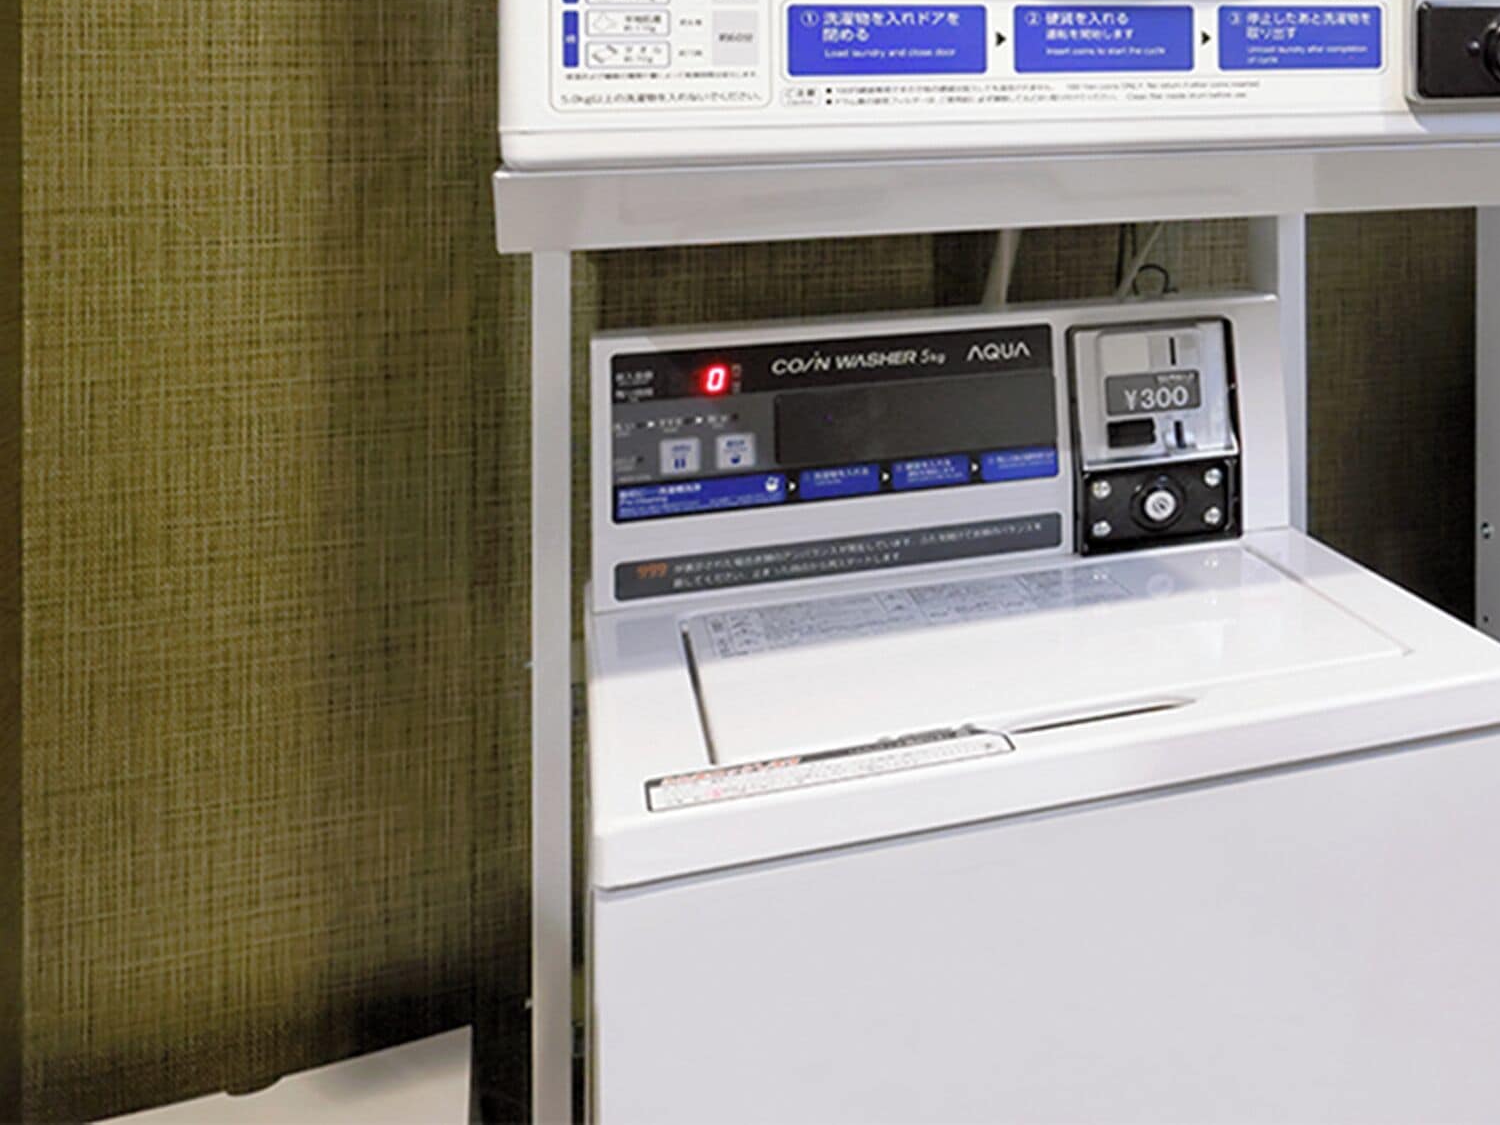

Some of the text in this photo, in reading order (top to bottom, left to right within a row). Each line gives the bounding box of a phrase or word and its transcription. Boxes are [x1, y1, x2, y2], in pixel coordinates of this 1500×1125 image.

[822, 11, 960, 26] 洗濯物を入れドアを
[822, 28, 870, 43] 閉める
[836, 349, 916, 370] WASHER
[966, 341, 1030, 360] AQUA
[705, 366, 727, 393] 0
[1125, 385, 1189, 410] ¥300
